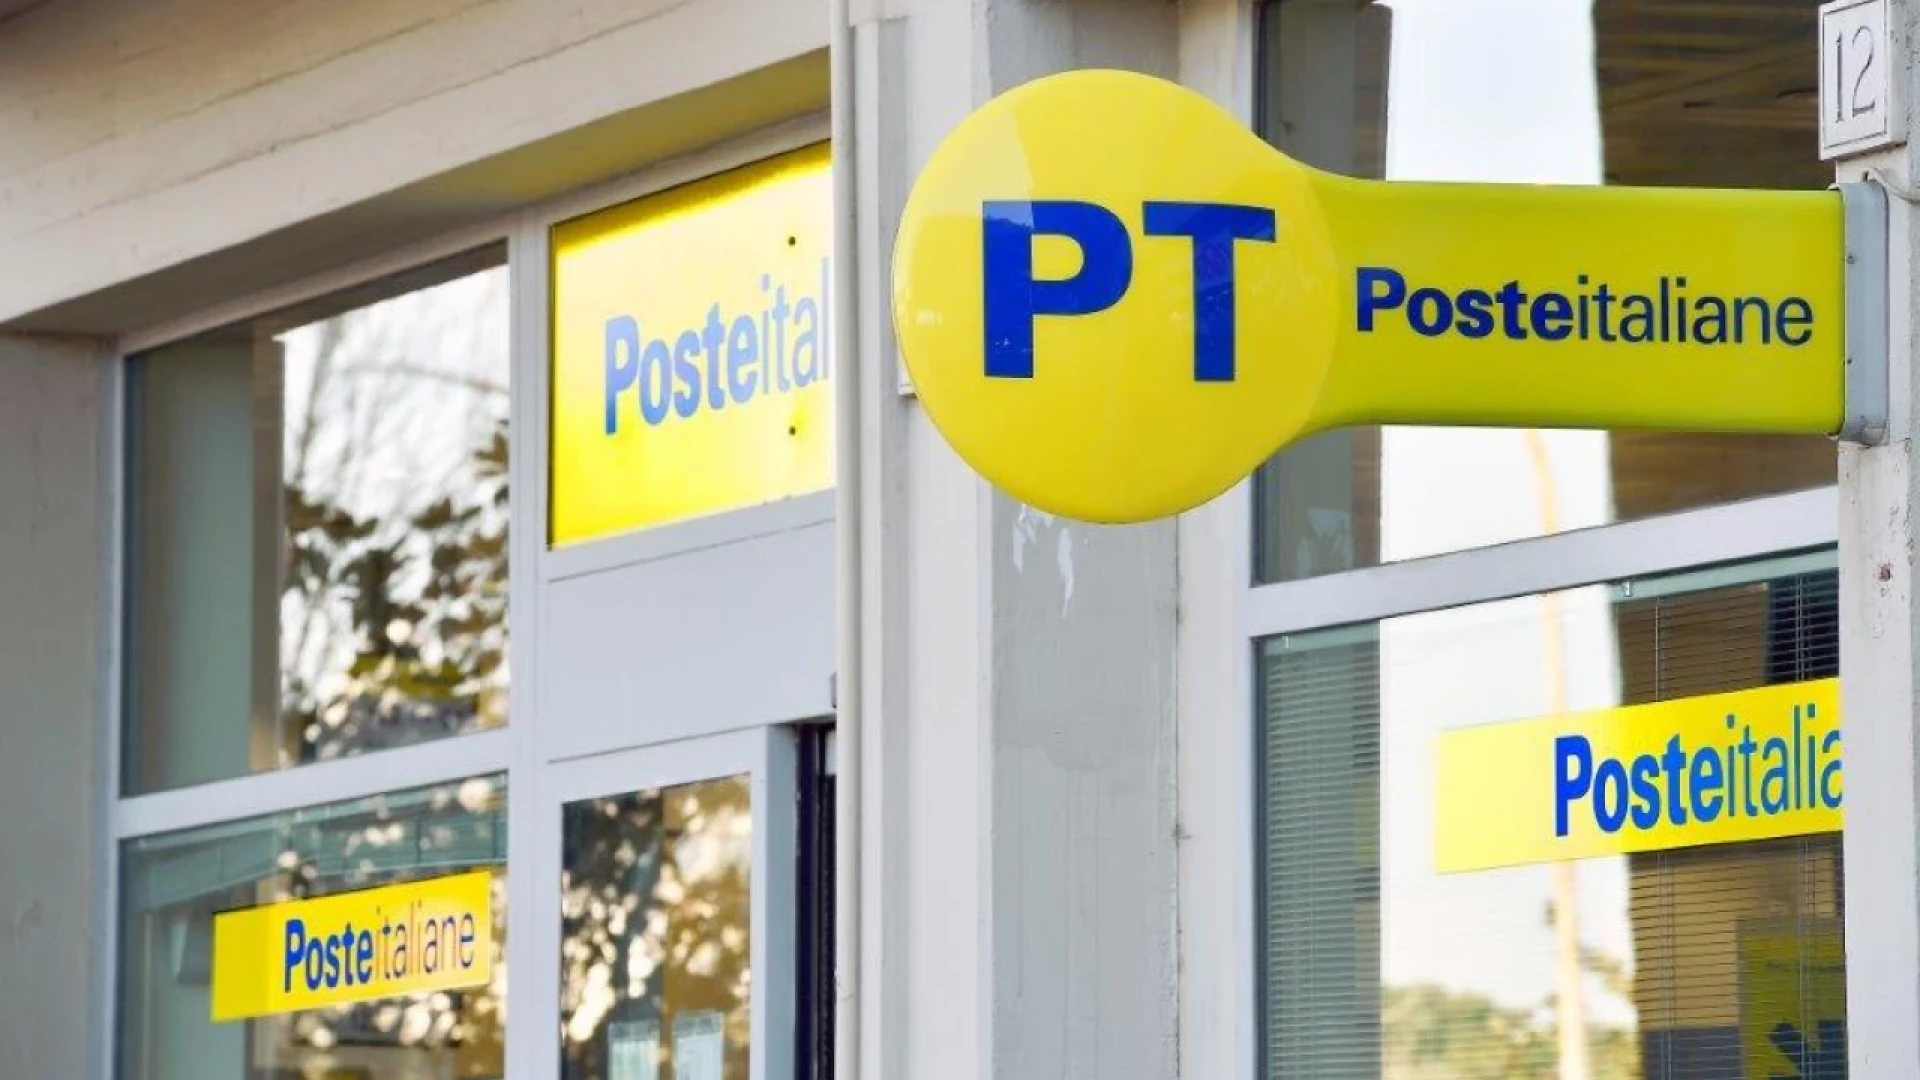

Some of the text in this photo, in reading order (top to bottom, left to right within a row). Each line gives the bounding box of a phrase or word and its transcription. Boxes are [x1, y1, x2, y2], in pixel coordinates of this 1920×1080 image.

[1835, 25, 1876, 123] 12
[981, 200, 1276, 382] PT
[1356, 268, 1813, 346] Posteitaliane
[284, 900, 474, 993] Posteitaliane
